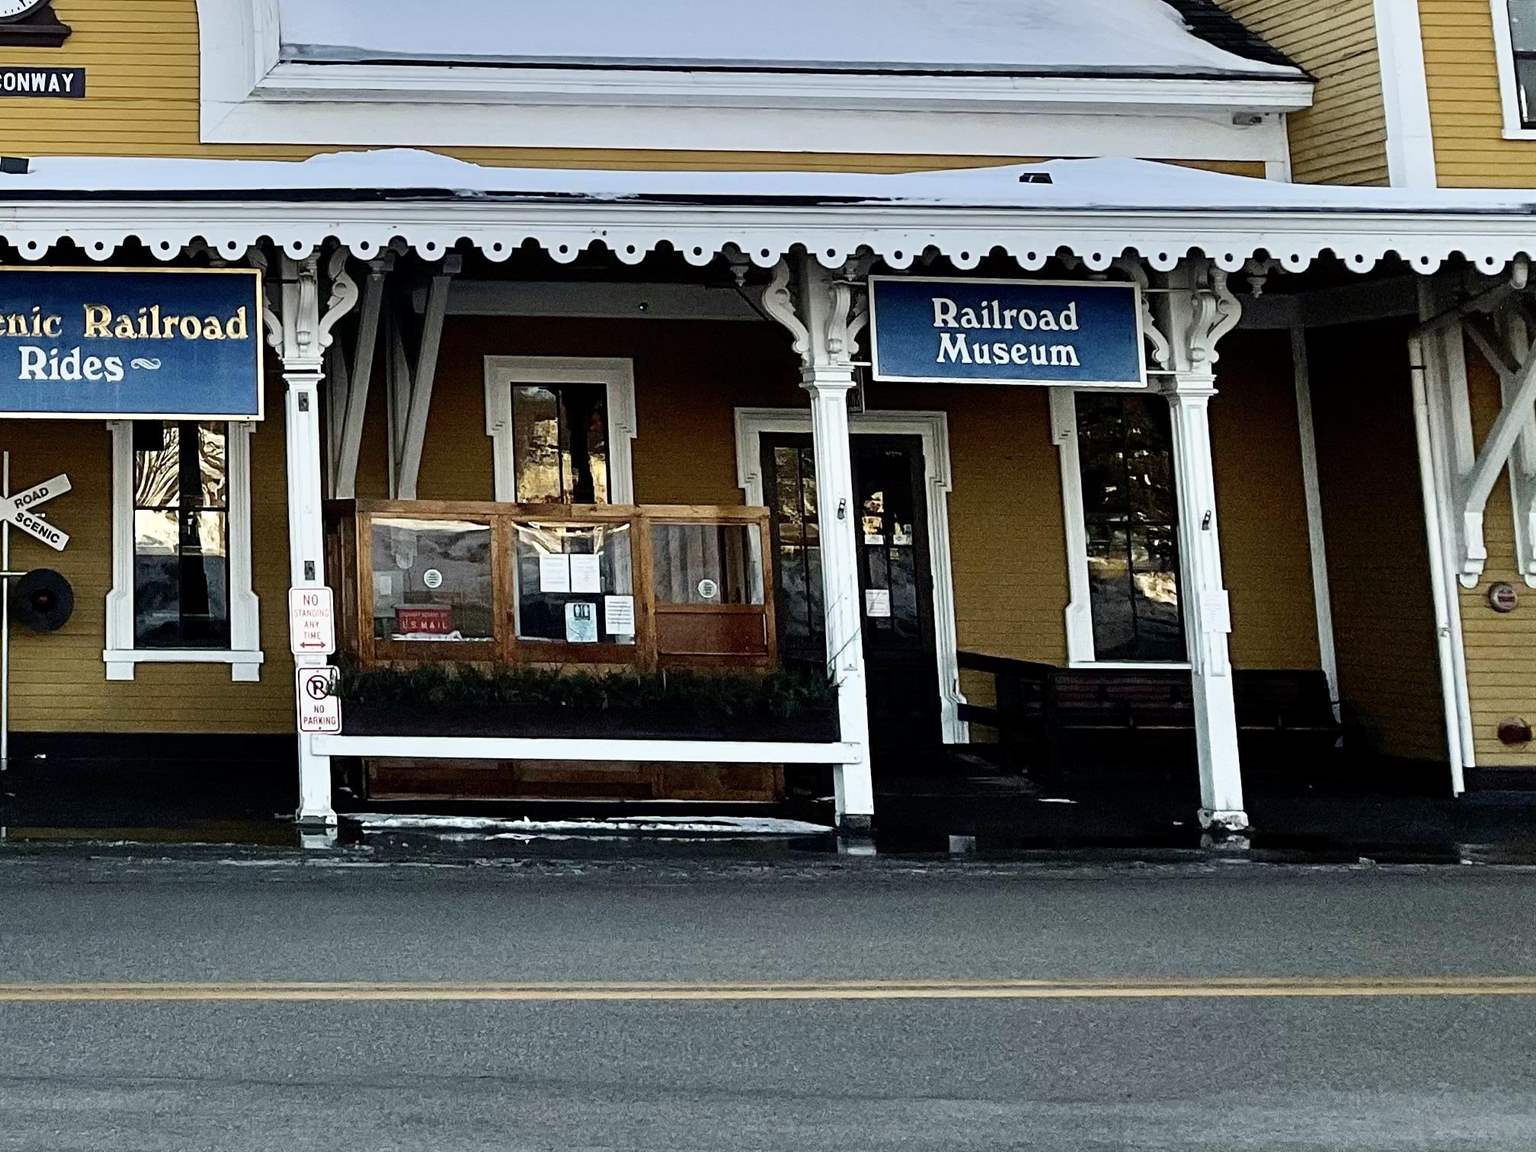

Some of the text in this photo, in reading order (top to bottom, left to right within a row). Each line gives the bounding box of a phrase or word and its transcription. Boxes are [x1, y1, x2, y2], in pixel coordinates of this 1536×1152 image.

[931, 298, 1080, 331] Railroad
[83, 303, 249, 340] Railroad
[936, 333, 1080, 367] Museum
[18, 345, 125, 383] Rides
[14, 487, 49, 508] ROAD
[15, 512, 60, 543] SCENIC
[303, 594, 319, 606] NO
[294, 609, 330, 618] STANDING
[304, 621, 320, 629] ANY
[421, 620, 448, 630] MAIL
[304, 631, 321, 640] TIME
[313, 705, 325, 714] NO
[304, 716, 337, 726] PARKING
